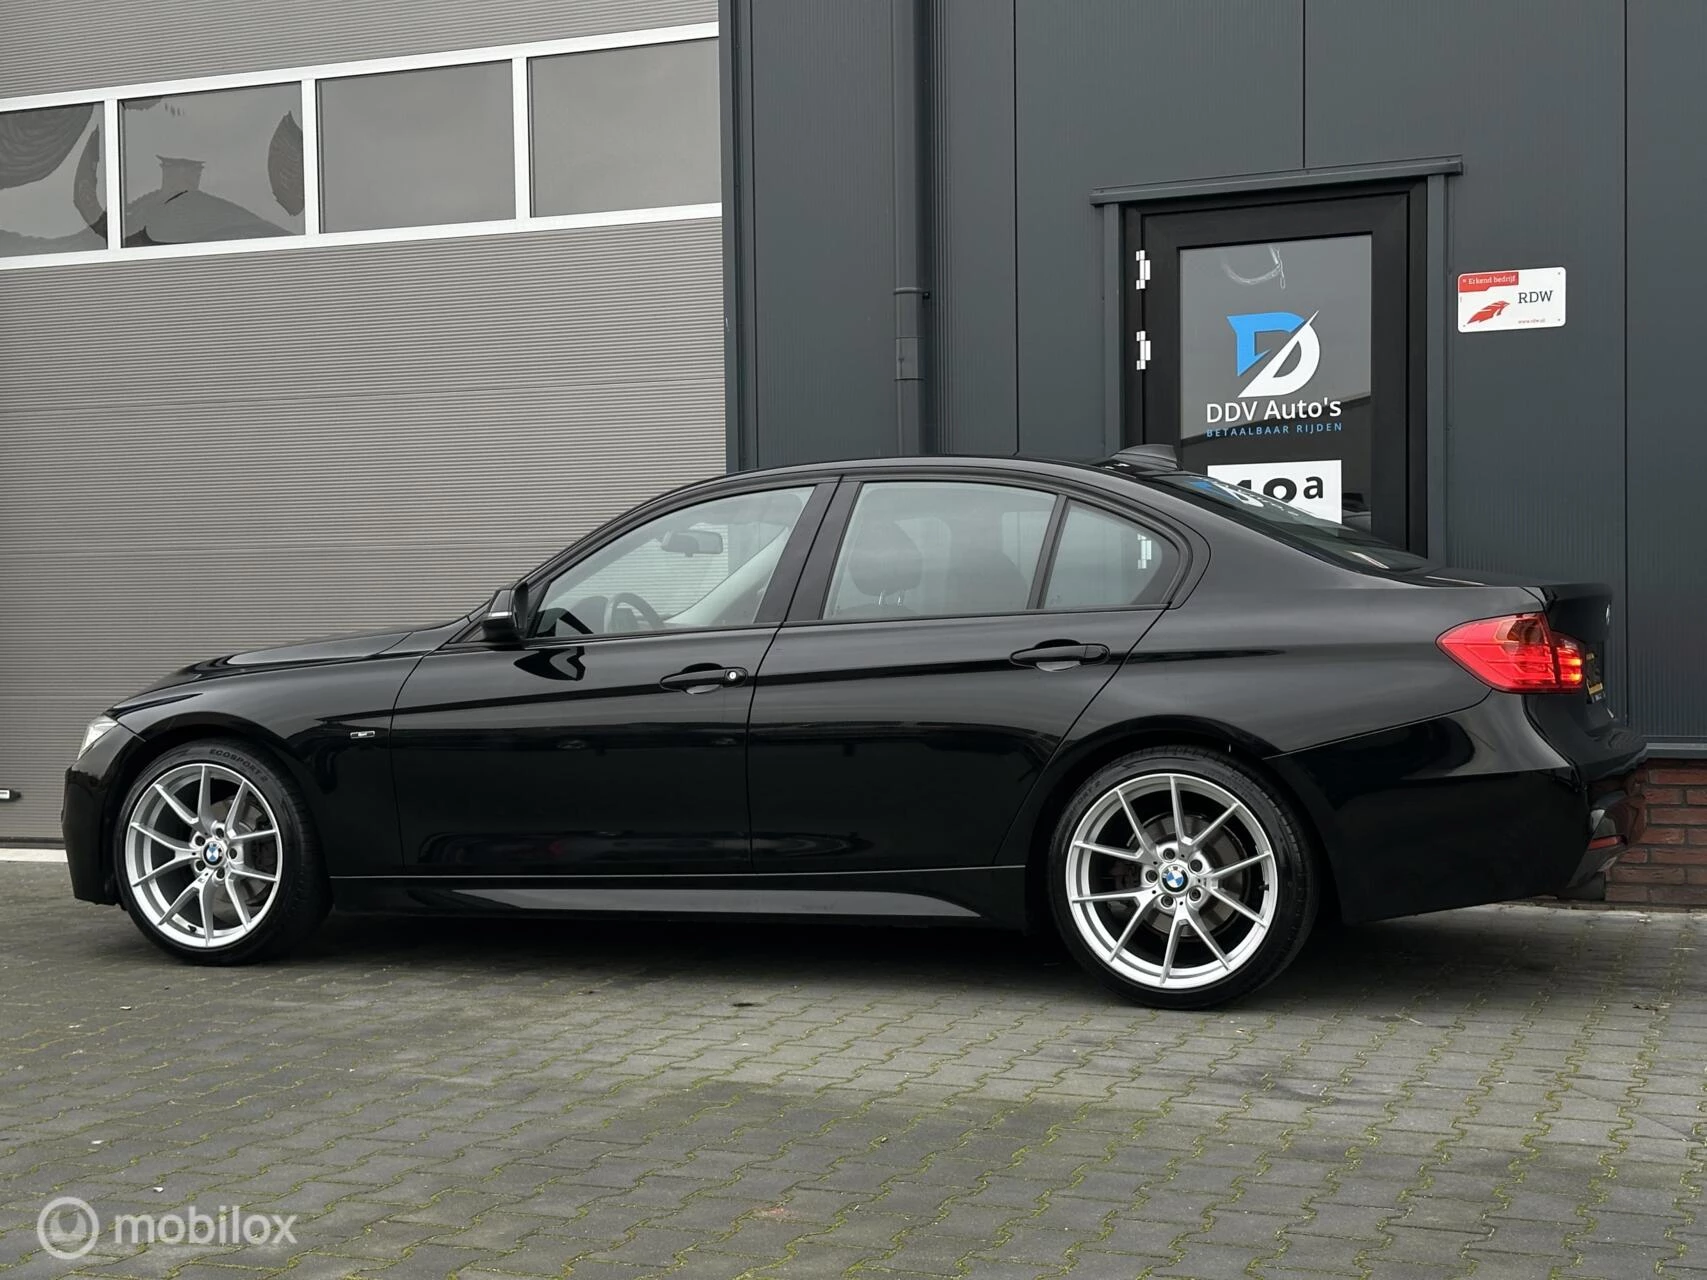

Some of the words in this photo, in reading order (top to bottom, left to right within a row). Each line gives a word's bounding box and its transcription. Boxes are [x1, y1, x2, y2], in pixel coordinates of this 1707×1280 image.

[1468, 276, 1492, 285] Erkend
[1493, 275, 1516, 284] bedrijf
[1518, 290, 1554, 304] RDW
[1206, 401, 1258, 423] DDV
[1263, 397, 1342, 420] Auto's
[1206, 425, 1289, 438] BETAALBAAR
[1296, 422, 1343, 434] RIJDEN
